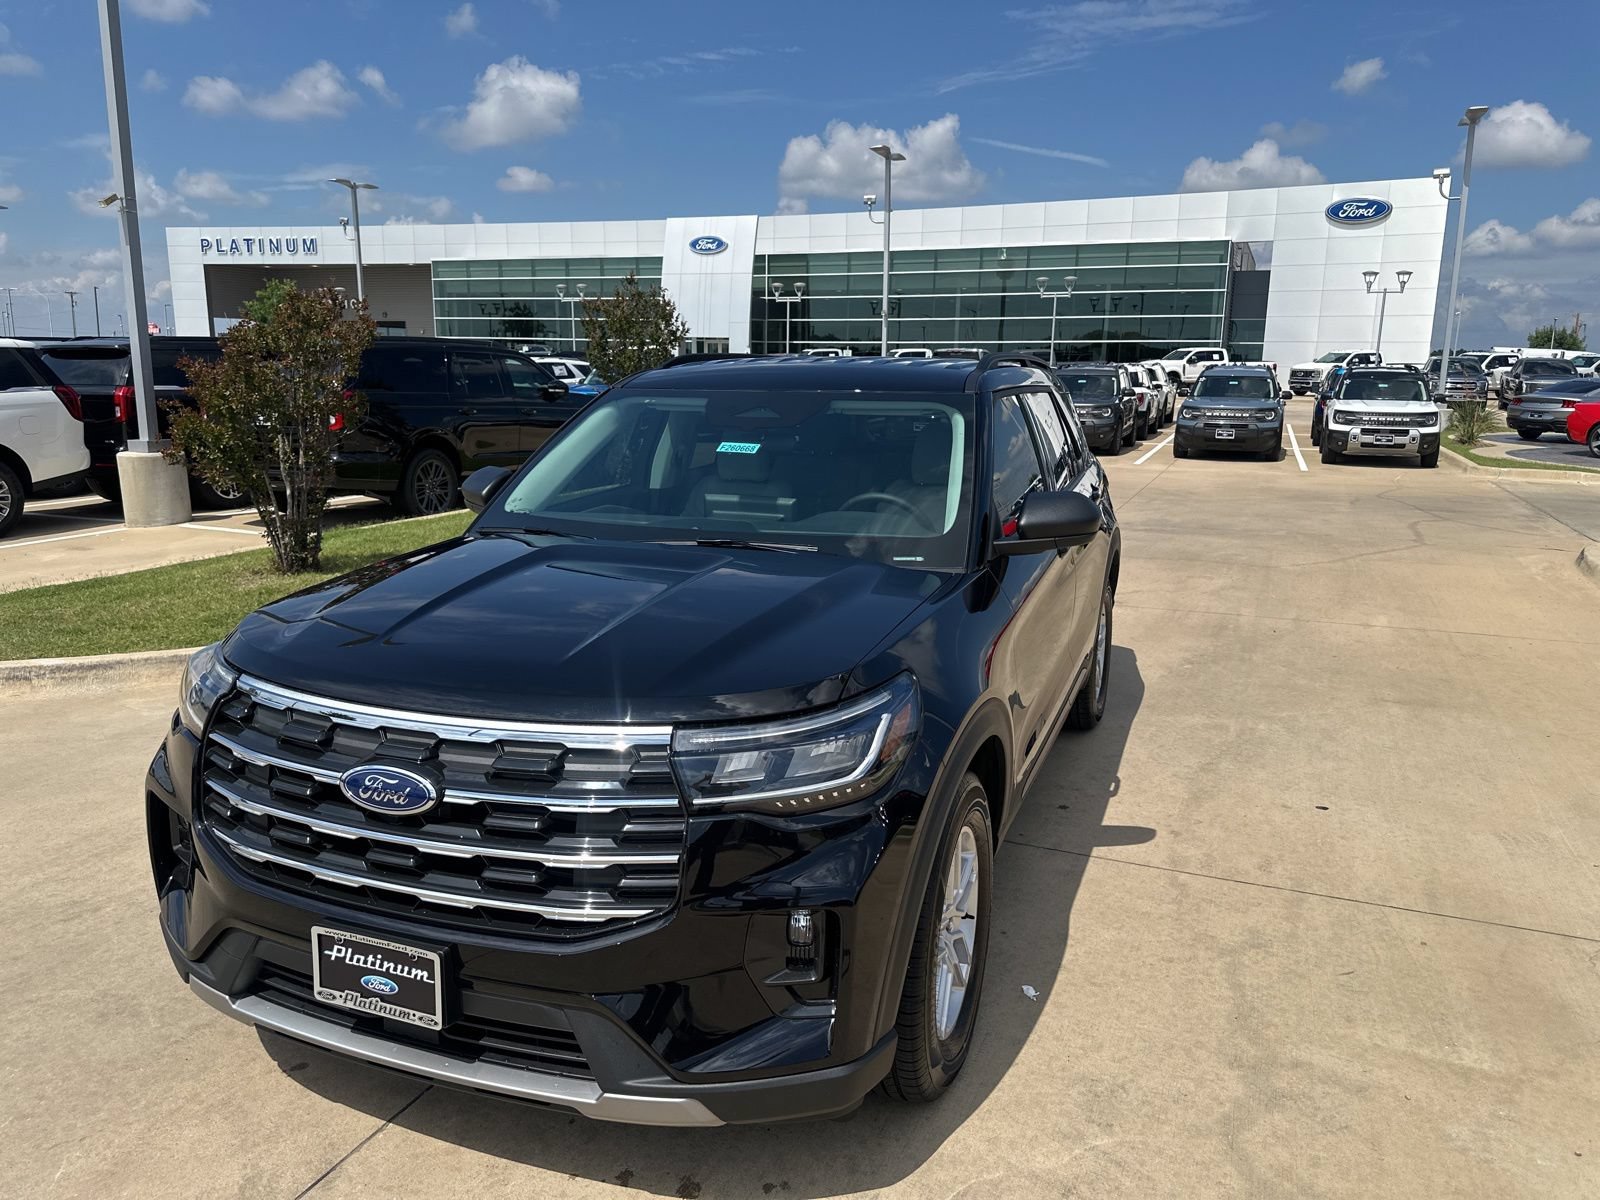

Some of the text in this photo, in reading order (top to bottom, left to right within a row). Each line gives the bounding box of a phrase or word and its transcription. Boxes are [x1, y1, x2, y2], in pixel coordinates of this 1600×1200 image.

[1338, 202, 1378, 217] Ford
[200, 237, 318, 254] PLATINUM
[695, 238, 719, 250] Ford
[358, 774, 412, 805] Ford
[323, 944, 435, 984] Platinum
[367, 977, 392, 993] Ford
[343, 992, 416, 1022] Platinum
